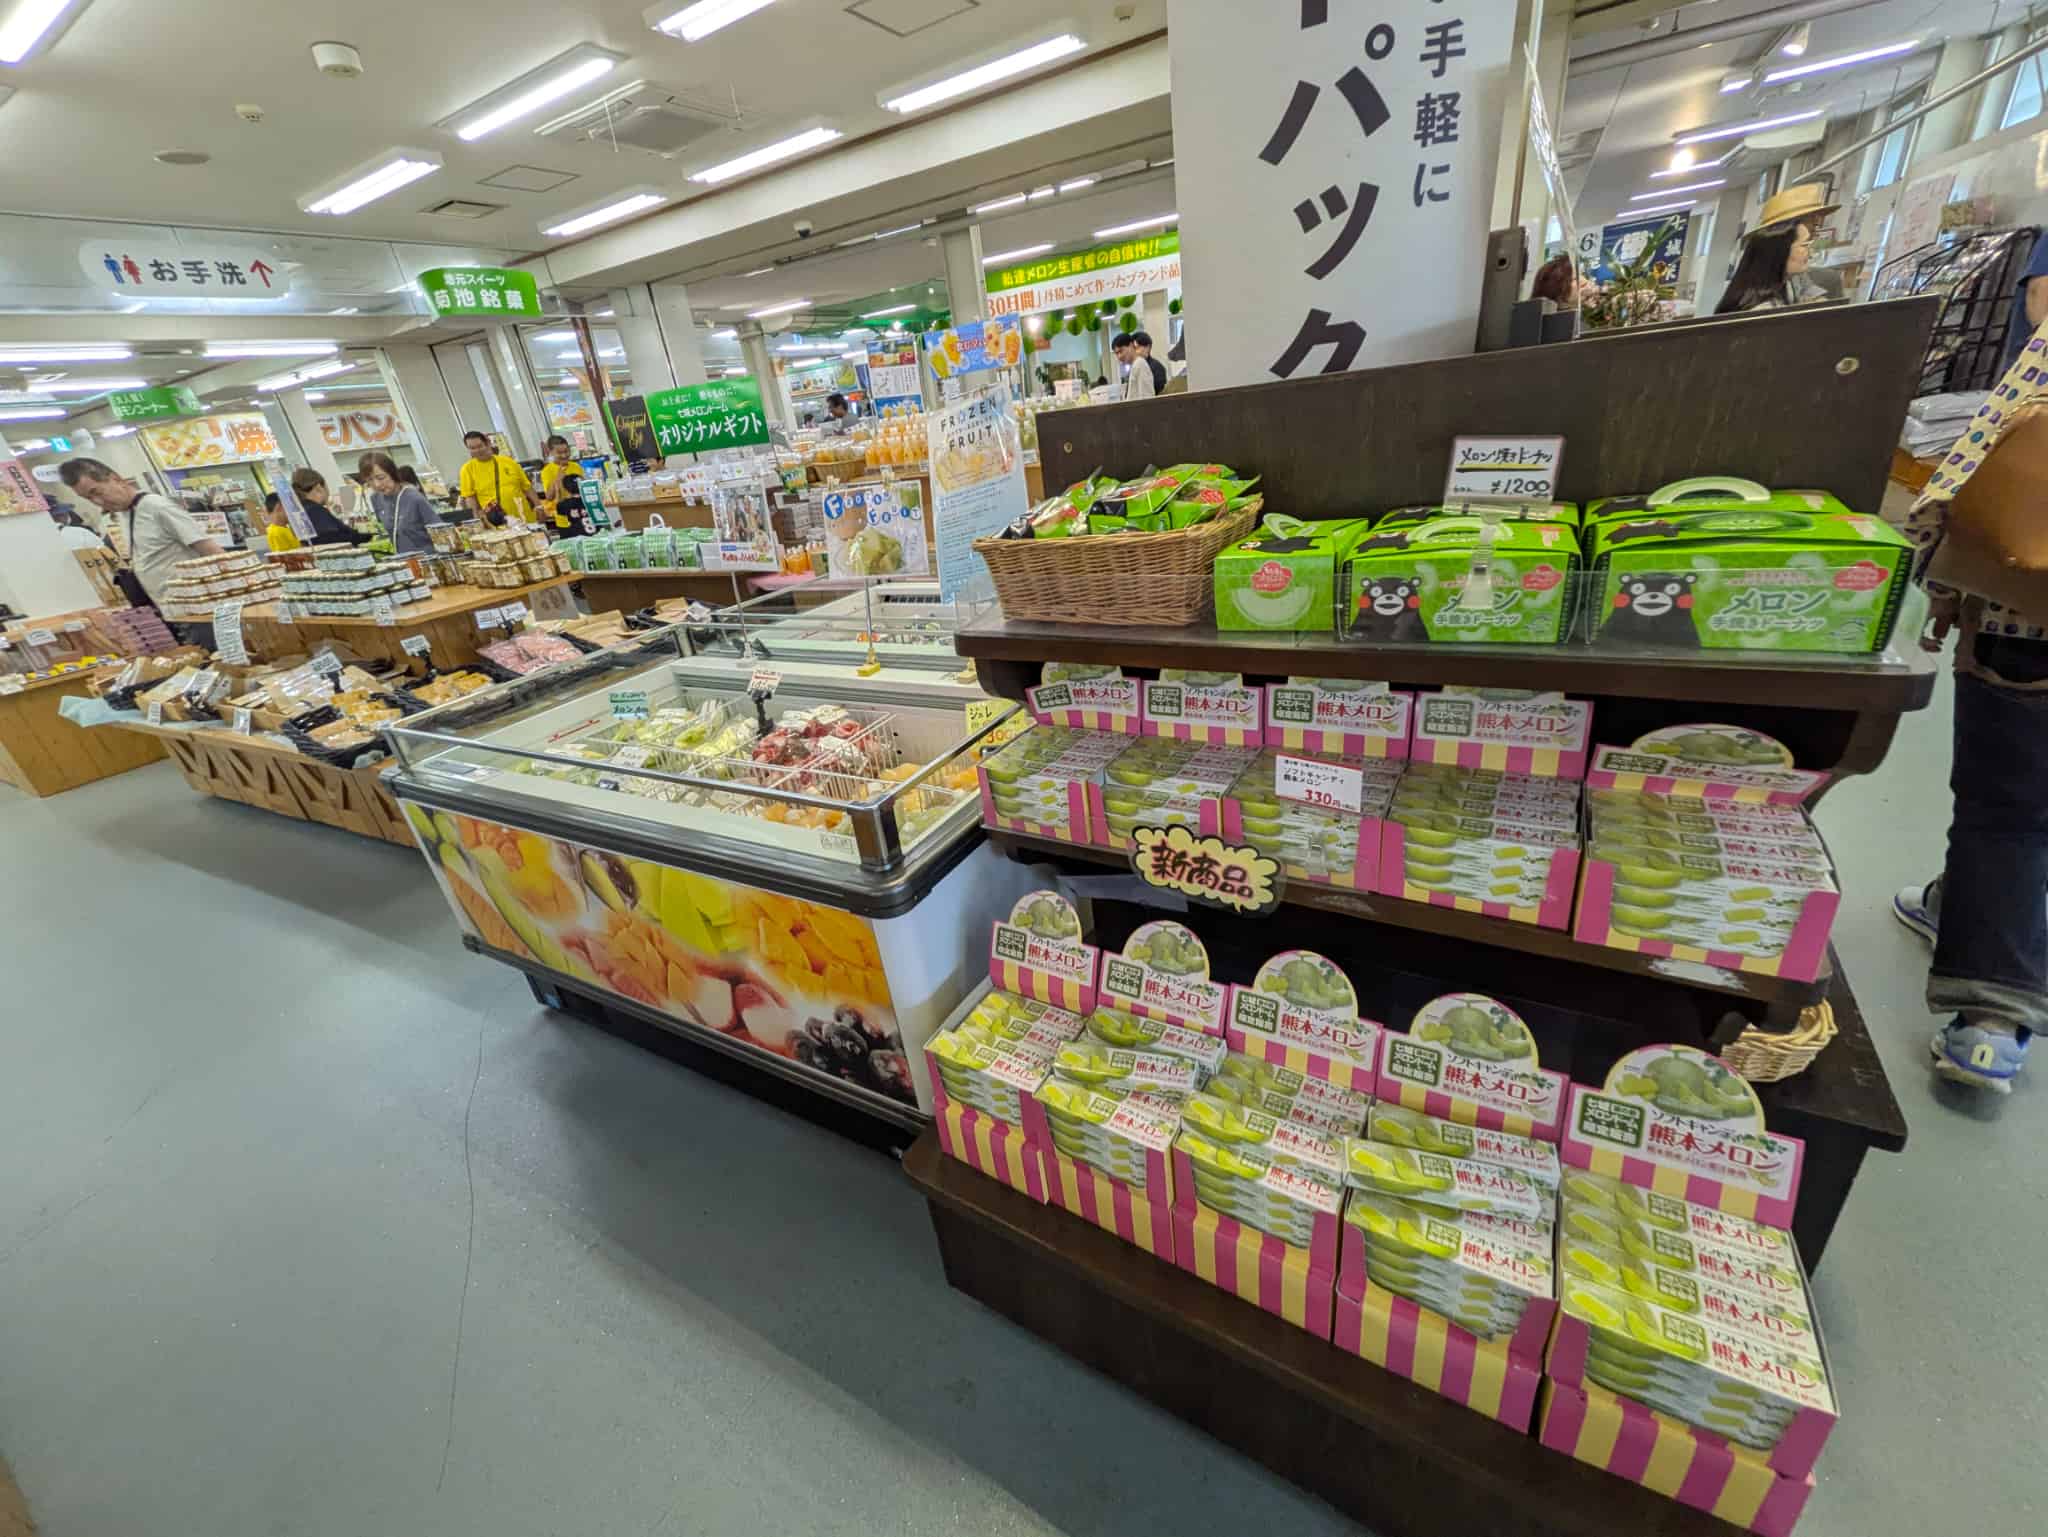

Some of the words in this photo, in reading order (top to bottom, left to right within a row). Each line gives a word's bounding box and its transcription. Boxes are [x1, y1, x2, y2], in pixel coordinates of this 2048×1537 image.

[1413, 0, 1466, 207] 手軽に
[1258, 0, 1396, 379] パック
[149, 258, 247, 285] お手洗
[443, 273, 505, 286] 地元スイーツ
[659, 413, 763, 446] オリジナルギフト
[949, 424, 994, 452] FRUIT
[1443, 590, 1521, 612] メン
[1721, 588, 1829, 614] メロン
[1072, 687, 1133, 700] 熊本メロン
[1184, 696, 1254, 712] 熊本メロン
[1316, 702, 1399, 720] 熊本メロン
[1476, 713, 1576, 733] 熊本メロン
[1284, 767, 1344, 784] ソフトキャンディ
[1284, 774, 1321, 785] 熊本メロン
[1151, 839, 1254, 899] 新商品
[1028, 943, 1088, 969] 熊本メロン
[1144, 979, 1216, 1009] 熊本メロン
[1281, 1013, 1367, 1047] 熊本メロン
[1445, 1065, 1551, 1104] 熊本メロン
[1648, 1123, 1783, 1170] 熊本メロン
[1456, 1169, 1528, 1194] 熊本メロン
[1691, 1213, 1781, 1250] 熊本メロン
[1464, 1241, 1545, 1278] 熊本メロン
[1698, 1251, 1795, 1293] 熊本メロン
[1704, 1295, 1805, 1338] 熊本メロン
[1712, 1341, 1819, 1389] 熊本メロン
